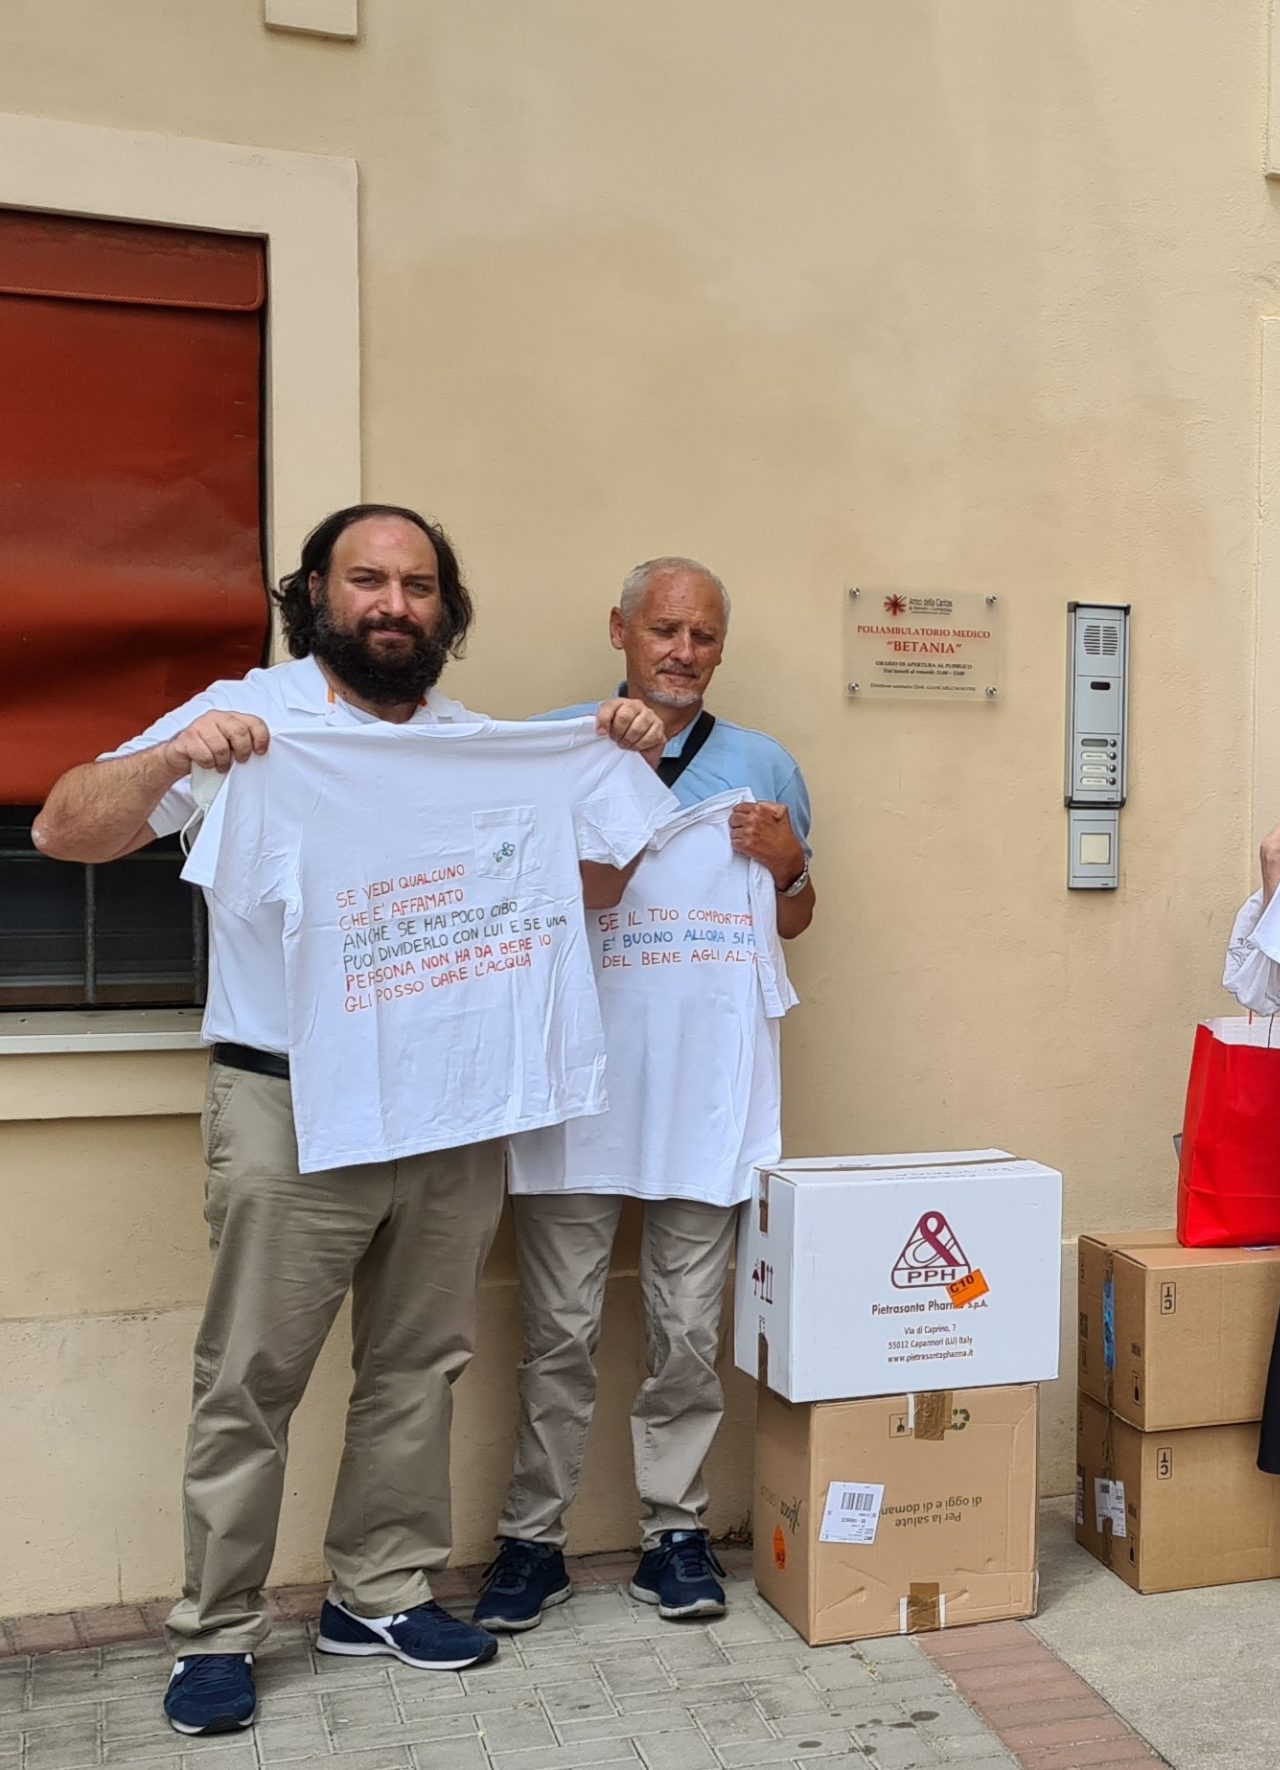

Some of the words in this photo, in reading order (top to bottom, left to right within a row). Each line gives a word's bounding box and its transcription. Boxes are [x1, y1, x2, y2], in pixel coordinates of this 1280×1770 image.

[857, 625, 951, 638] POLIAMBULATORIO
[952, 630, 990, 639] MEDICO
[336, 889, 356, 908] SE
[362, 877, 394, 901] VEDI
[399, 863, 465, 890] QUALCUNO
[339, 914, 368, 931] CHE
[391, 888, 464, 919] AFFAMATO
[343, 926, 391, 953] ANCHE
[397, 920, 416, 937] SE
[424, 914, 447, 934] HAI
[451, 906, 484, 926] POCO
[490, 901, 518, 918] CIBO
[598, 912, 621, 933] SE
[627, 911, 643, 927] IL
[648, 908, 680, 923] TUO
[343, 952, 374, 973] PUOI
[380, 934, 448, 962] DIVIDERLO
[452, 927, 479, 945] CON
[484, 924, 503, 936] LUI
[510, 920, 519, 933] E
[524, 916, 542, 930] SE
[546, 916, 567, 928] UNA
[623, 931, 673, 948] BUONO
[683, 929, 726, 943] ALLORA
[732, 931, 744, 944] SI
[346, 960, 416, 992] PERSONA
[421, 953, 449, 972] NON
[455, 947, 471, 964] HA
[475, 944, 493, 960] DA
[500, 936, 533, 955] BERE
[539, 934, 552, 947] IO
[602, 955, 632, 969] DEL
[641, 951, 682, 966] BENE
[690, 949, 720, 962] AGLI
[344, 994, 372, 1013] GLI
[376, 981, 424, 1005] POSSO
[431, 967, 469, 989] DARE
[475, 952, 531, 977] L'ACQUA
[907, 1269, 956, 1283] PPH
[950, 1274, 975, 1293] C10
[872, 1303, 925, 1315] Pietrasanta
[904, 1327, 915, 1335] Via
[916, 1326, 923, 1334] di
[952, 1323, 957, 1332] 7
[888, 1340, 909, 1350] 55012
[945, 1336, 958, 1346] (LU)
[959, 1336, 973, 1346] Italy
[924, 1498, 935, 1510] di
[935, 1500, 943, 1508] e
[945, 1496, 969, 1508] oggi
[972, 1496, 983, 1506] di
[895, 1514, 929, 1527] salute
[931, 1513, 941, 1524] la
[942, 1511, 962, 1522] Per
